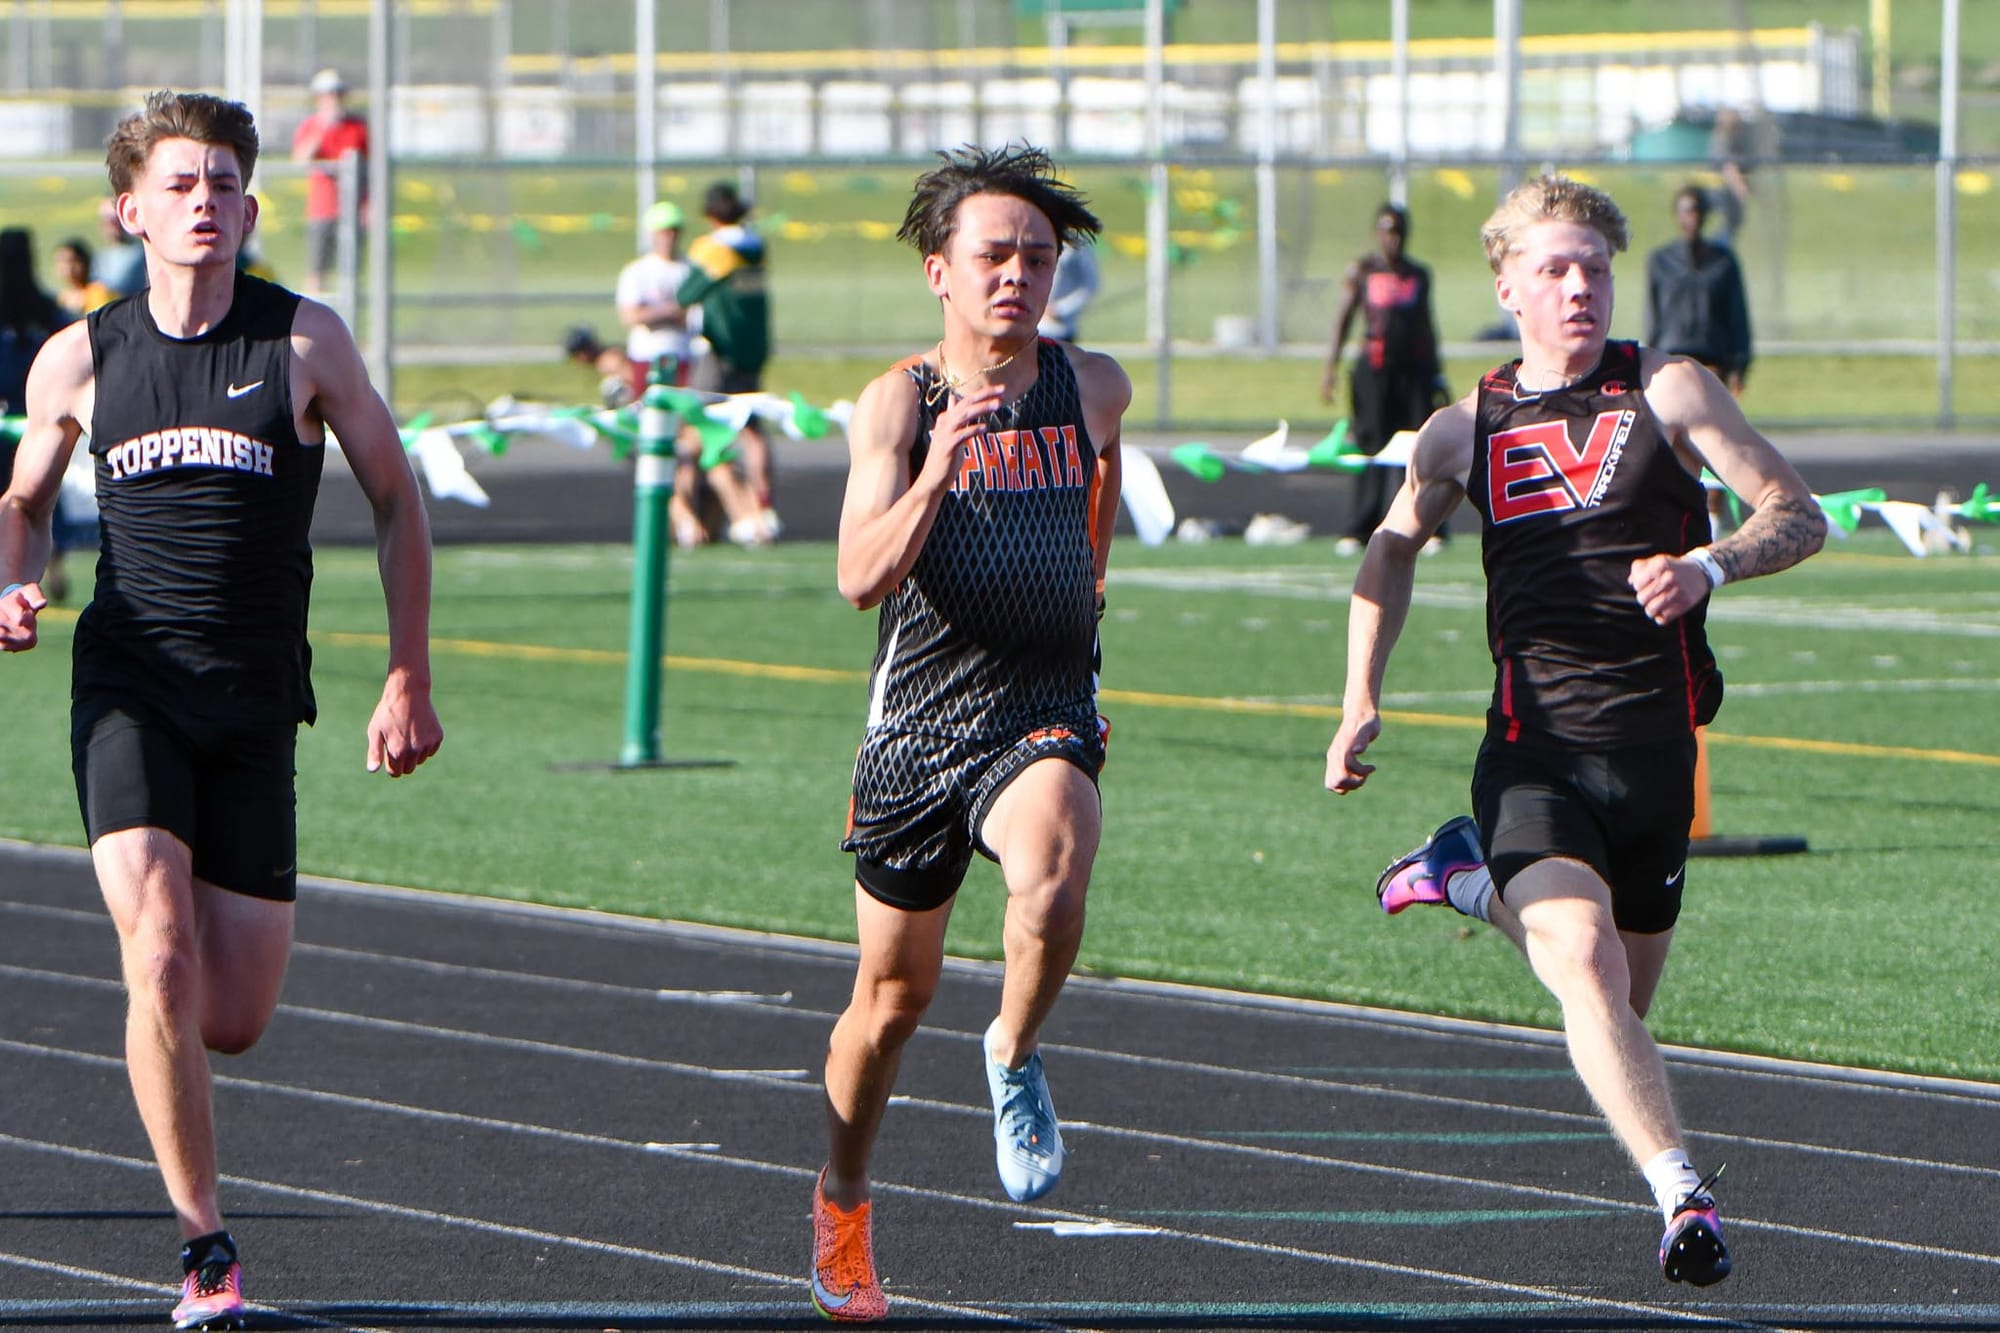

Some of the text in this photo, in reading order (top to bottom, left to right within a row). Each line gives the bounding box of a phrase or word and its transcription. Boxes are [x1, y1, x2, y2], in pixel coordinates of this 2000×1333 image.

[106, 425, 274, 481] TOPPENISH
[948, 424, 1084, 492] PHRATA
[1487, 409, 1626, 525] EV
